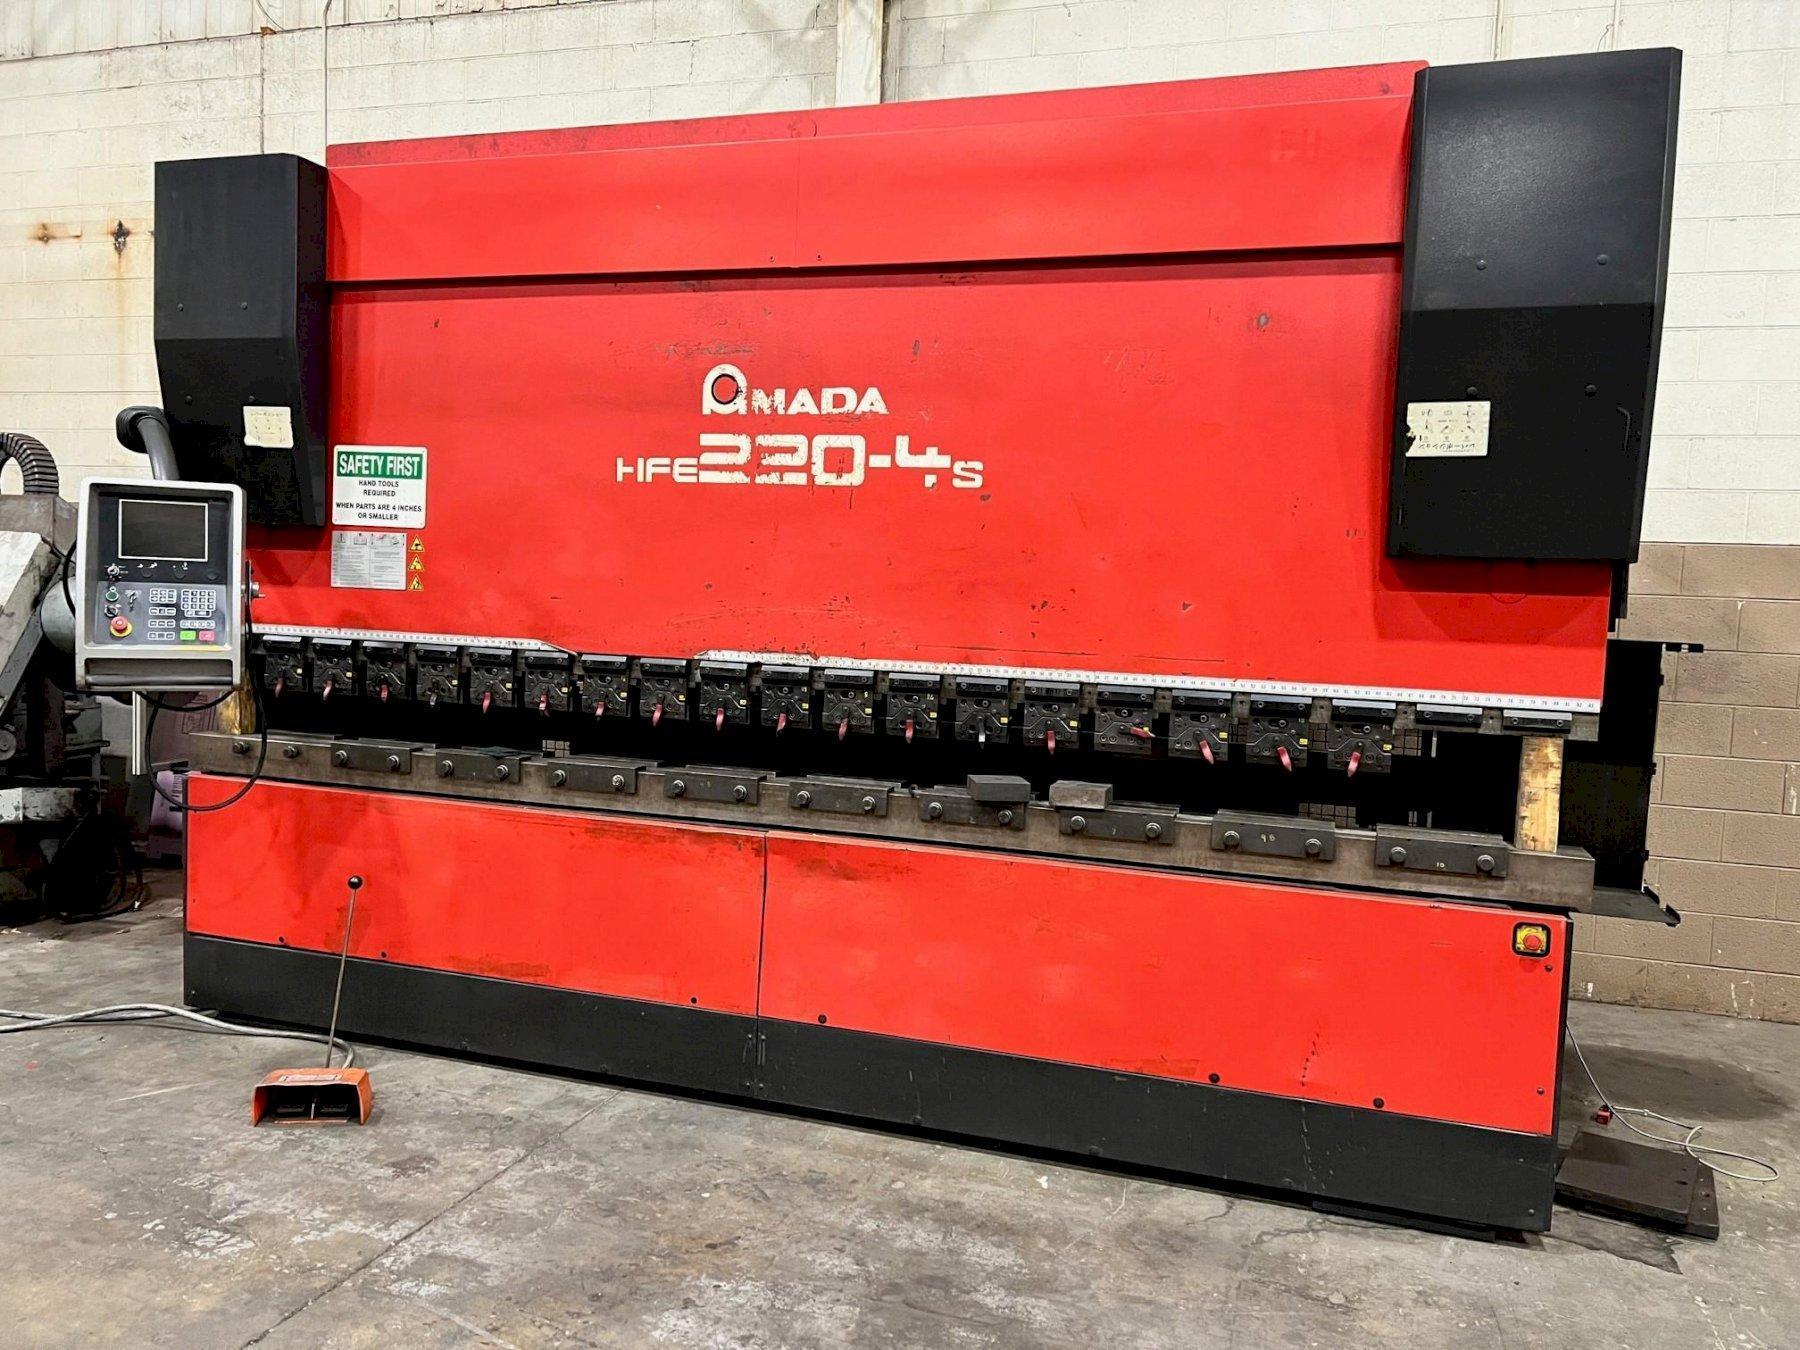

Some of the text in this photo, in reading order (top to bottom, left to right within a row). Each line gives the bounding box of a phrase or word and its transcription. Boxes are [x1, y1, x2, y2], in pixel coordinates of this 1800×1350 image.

[702, 363, 889, 415] AMADA
[339, 453, 420, 477] SAFETY FIRST
[378, 480, 399, 488] TOOLS
[363, 489, 396, 497] REQUIRED
[355, 502, 376, 510] PARTS
[377, 503, 390, 511] ARE
[397, 504, 422, 512] INCHES
[368, 512, 398, 520] SMALLER
